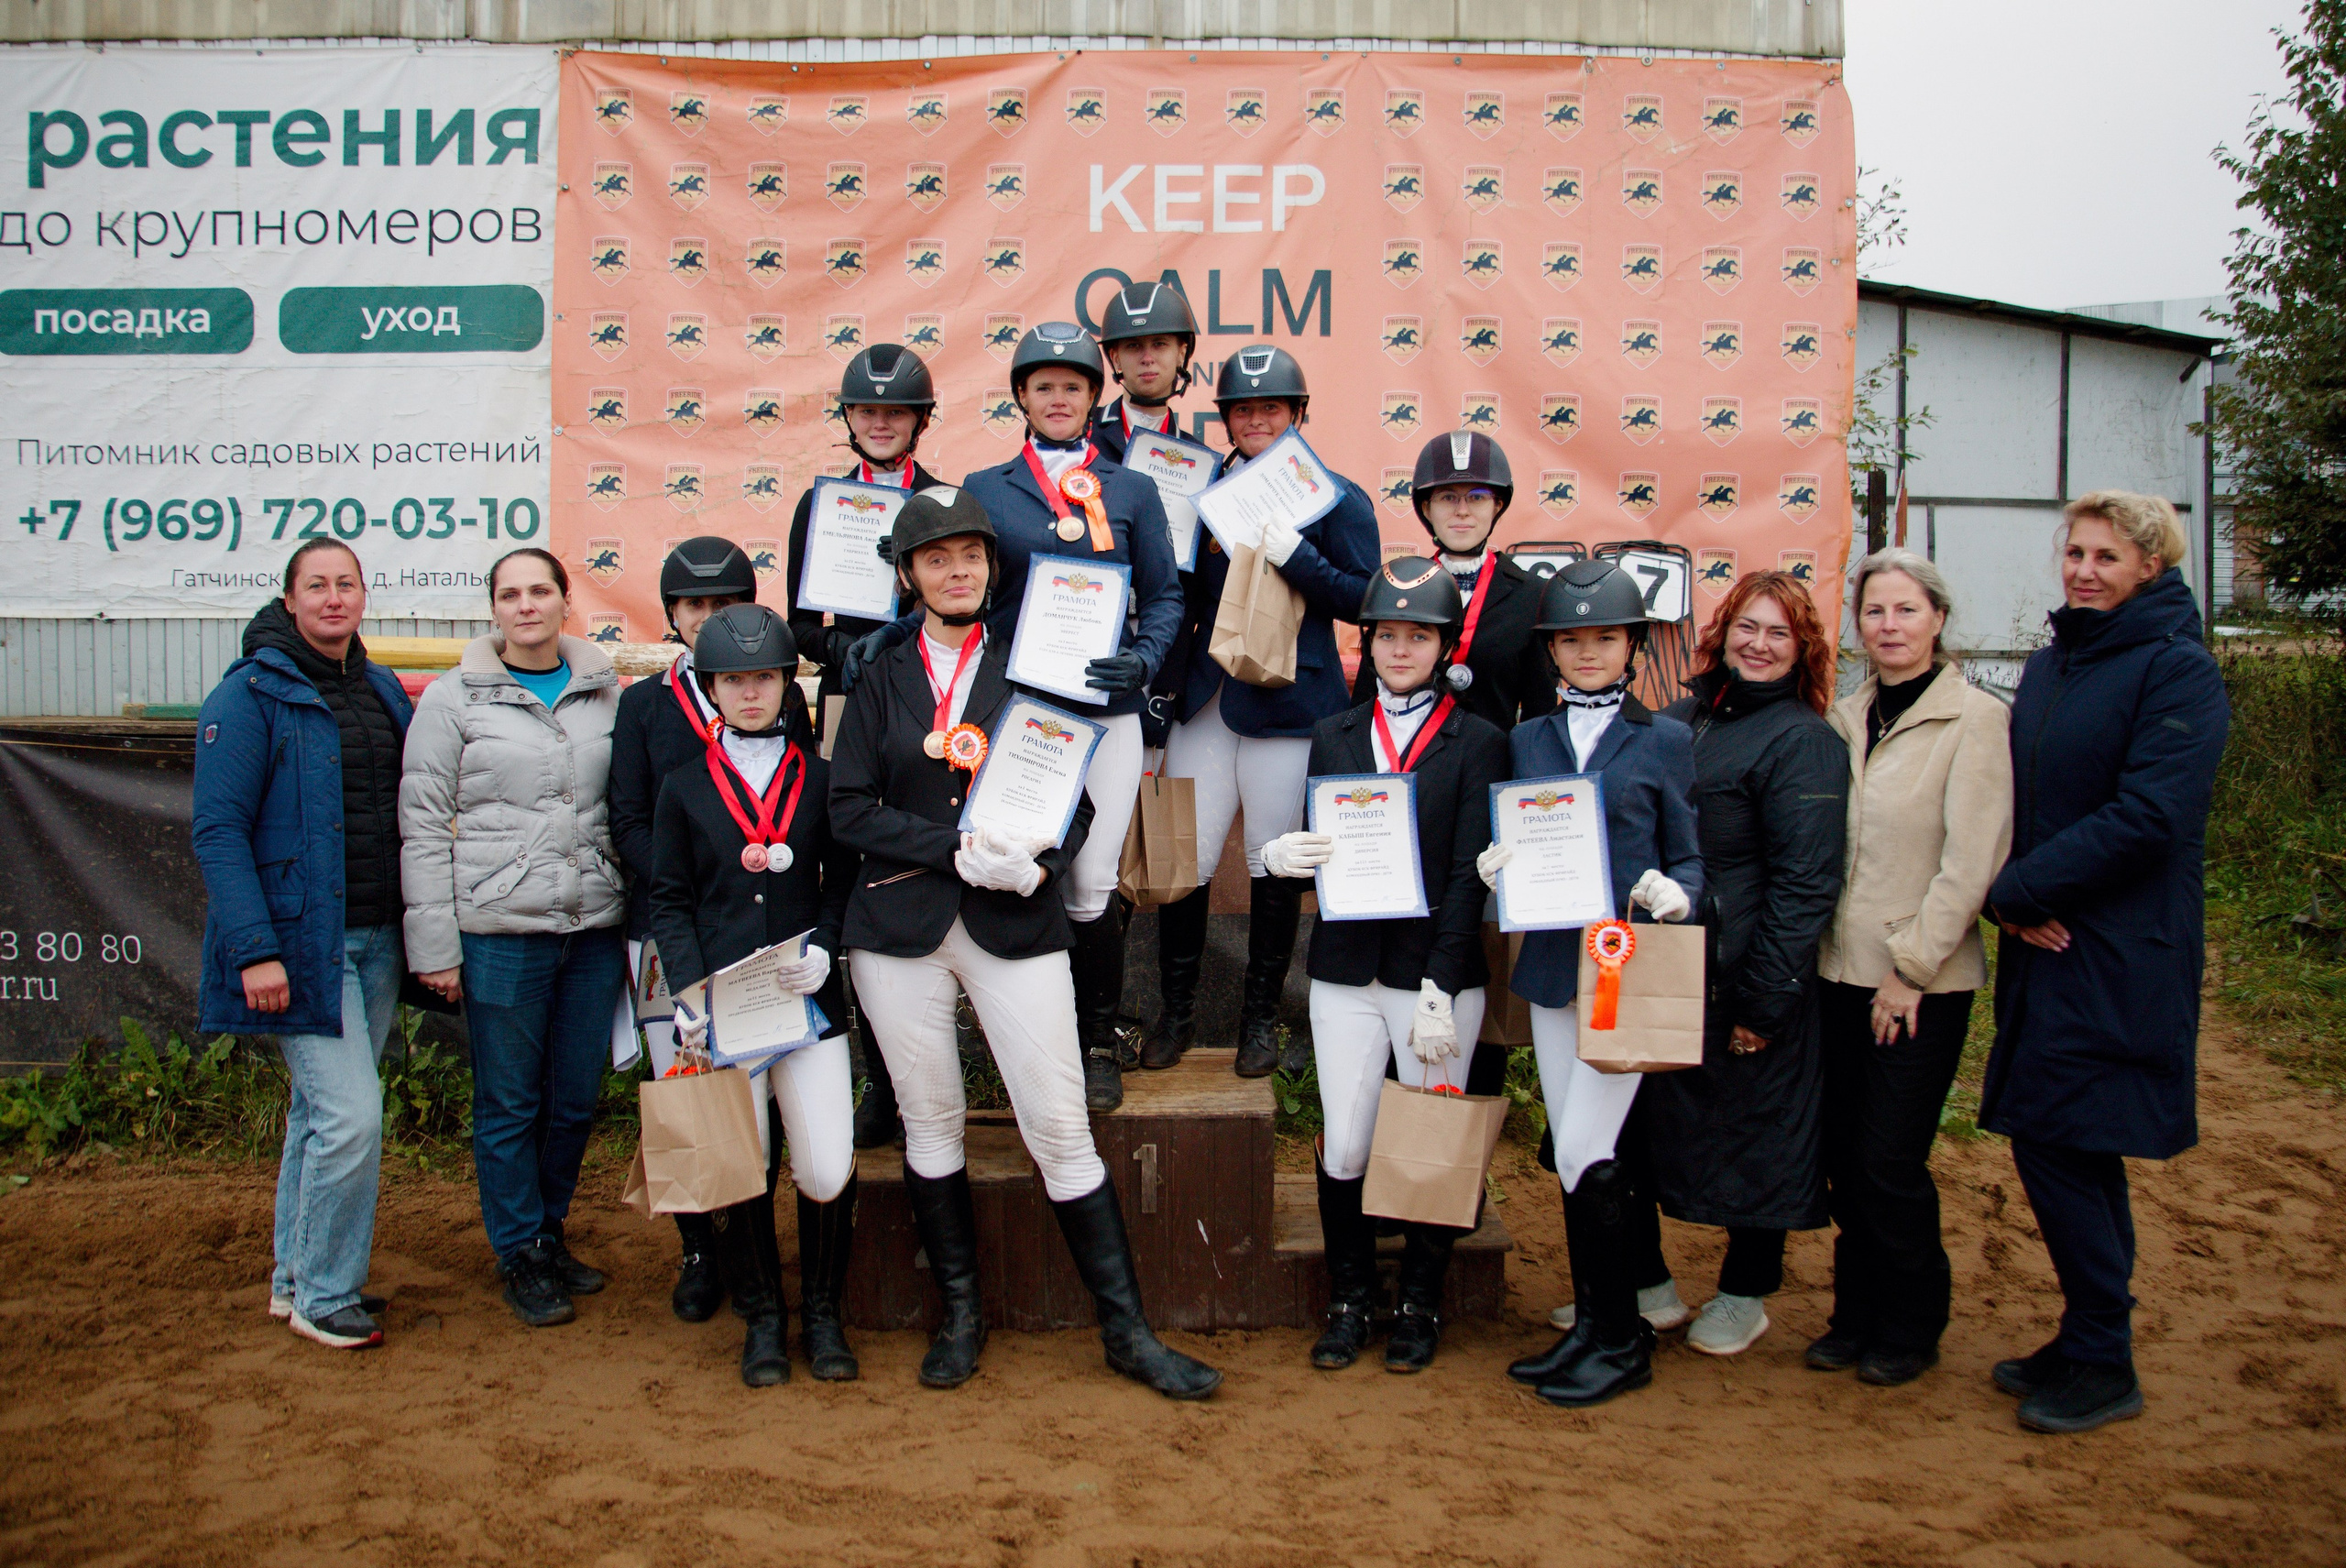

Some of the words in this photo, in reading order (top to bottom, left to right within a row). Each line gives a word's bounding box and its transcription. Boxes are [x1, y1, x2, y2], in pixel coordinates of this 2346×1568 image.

[992, 91, 1023, 99] FREERIDE
[1071, 92, 1102, 100] FREERIDE
[1151, 92, 1183, 100] FREERIDE
[1231, 92, 1262, 100] FREERIDE
[1310, 92, 1342, 100] FREERIDE
[1389, 92, 1420, 100] FREERIDE
[1469, 93, 1500, 102] FREERIDE
[1549, 95, 1580, 104] FREERIDE
[1628, 97, 1659, 105] FREERIDE
[1708, 99, 1738, 107] FREERIDE
[1786, 103, 1815, 111] FREERIDE
[28, 108, 541, 190] растения
[597, 165, 630, 173] FREERIDE
[674, 166, 706, 174] FREERIDE
[752, 165, 784, 173] FREERIDE
[831, 166, 862, 174] FREERIDE
[911, 166, 943, 174] FREERIDE
[992, 167, 1022, 175] FREERIDE
[1388, 167, 1420, 175] FREERIDE
[1468, 169, 1499, 177] FREERIDE
[1548, 170, 1579, 179] FREERIDE
[1628, 172, 1659, 181] FREERIDE
[1707, 174, 1738, 182] FREERIDE
[1785, 176, 1816, 184] FREERIDE
[1090, 164, 1326, 233] KEEP
[0, 211, 71, 255] до
[97, 207, 543, 259] крупномеров
[597, 240, 626, 248] FREERIDE
[674, 241, 704, 249] FREERIDE
[751, 241, 783, 249] FREERIDE
[830, 242, 862, 250] FREERIDE
[911, 242, 942, 250] FREERIDE
[990, 241, 1021, 249] FREERIDE
[1387, 242, 1419, 250] FREERIDE
[1467, 243, 1498, 251] FREERIDE
[1547, 246, 1578, 254] FREERIDE
[1627, 247, 1658, 256] FREERIDE
[1706, 249, 1738, 258] FREERIDE
[1787, 250, 1817, 258] FREERIDE
[361, 303, 461, 341] уход
[595, 314, 625, 323] FREERIDE
[672, 315, 704, 323] FREERIDE
[751, 317, 783, 325] FREERIDE
[830, 317, 861, 325] FREERIDE
[909, 317, 940, 325] FREERIDE
[989, 316, 1020, 324] FREERIDE
[34, 306, 212, 340] посадка
[1387, 319, 1419, 327] FREERIDE
[1466, 319, 1498, 327] FREERIDE
[1546, 321, 1578, 329] FREERIDE
[1627, 323, 1658, 332] FREERIDE
[1706, 323, 1738, 332] FREERIDE
[1786, 325, 1817, 334] FREERIDE
[593, 390, 624, 399] FREERIDE
[671, 390, 702, 399] FREERIDE
[750, 391, 780, 400] FREERIDE
[1387, 394, 1417, 402] FREERIDE
[1466, 396, 1496, 404] FREERIDE
[1545, 397, 1577, 405] FREERIDE
[1626, 399, 1657, 407] FREERIDE
[1706, 400, 1738, 408] FREERIDE
[1786, 401, 1817, 410] FREERIDE
[17, 438, 201, 466] Питомник
[211, 441, 361, 469] садовых
[372, 435, 542, 470] растений
[592, 466, 622, 474] FREERIDE
[669, 466, 701, 474] FREERIDE
[1148, 463, 1188, 481] ГРАМОТА
[1543, 473, 1574, 481] FREERIDE
[1624, 475, 1656, 483] FREERIDE
[1705, 477, 1736, 485] FREERIDE
[1277, 467, 1306, 500] ГРАМОТА
[1784, 477, 1816, 486] FREERIDE
[838, 513, 881, 526] ГРАМОТА
[19, 499, 82, 541] +7
[104, 497, 242, 551] (969)
[263, 497, 542, 542] 720-03-10
[590, 541, 620, 549] FREERIDE
[746, 542, 777, 550] FREERIDE
[1385, 546, 1415, 554] FREERIDE
[1701, 552, 1733, 560] FREERIDE
[1782, 554, 1814, 562] FREERIDE
[171, 568, 281, 587] Гатчинск
[372, 572, 392, 589] д.
[1637, 565, 1669, 612] 7
[1052, 594, 1097, 607] ГРАМОТА
[592, 616, 623, 624] FREERIDE
[1043, 612, 1077, 621] ДОМАНЧУК
[1021, 734, 1064, 756] ГРАМОТА
[1007, 751, 1047, 770] ТИХОМИРОВА
[1048, 767, 1067, 777] Елена
[1339, 810, 1385, 819] ГРАМОТА
[1522, 812, 1571, 825] ГРАМОТА
[1517, 837, 1547, 845] ФАТЕЕВА
[1549, 833, 1583, 841] Анастасия
[0, 930, 19, 960] 3
[37, 931, 82, 962] 80
[101, 934, 142, 964] 80
[736, 952, 778, 971] ГРАМОТА
[729, 972, 760, 986] МАТВЕЕВА
[0, 976, 60, 1001] r.ru
[1133, 1144, 1157, 1213] 1
